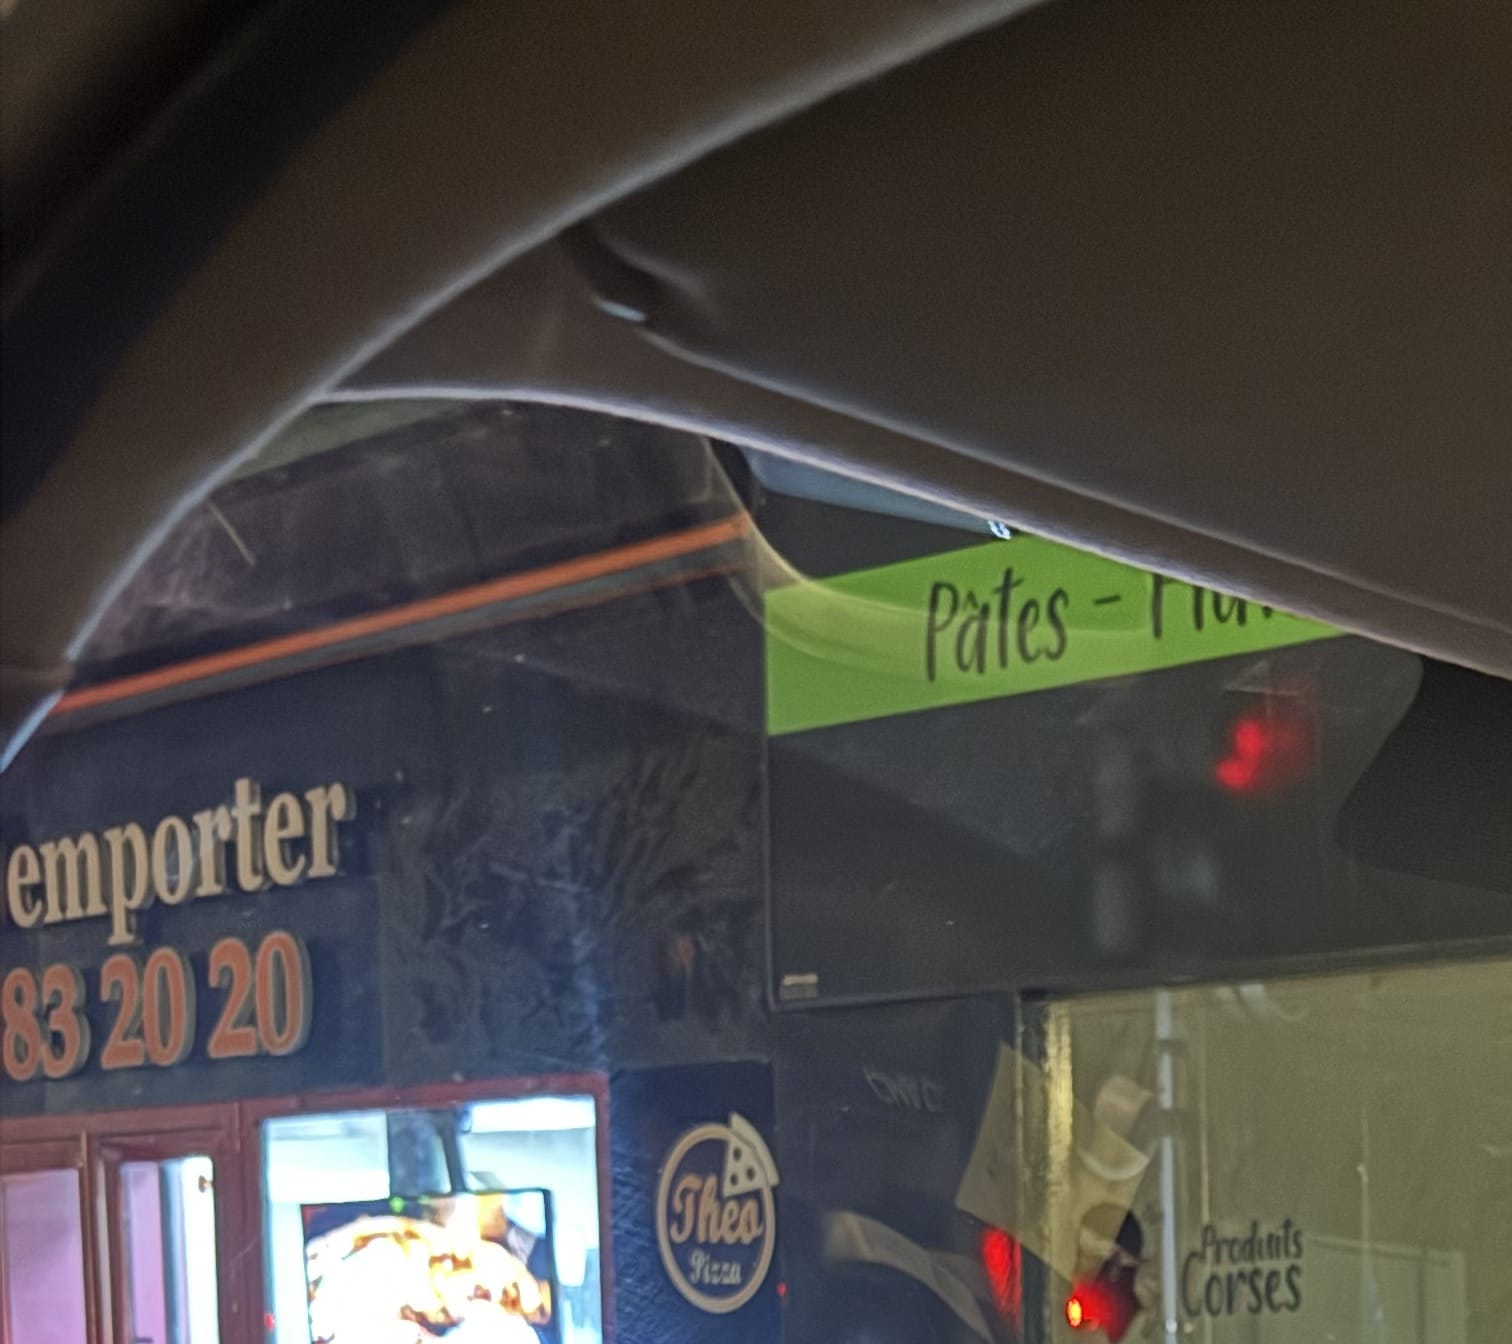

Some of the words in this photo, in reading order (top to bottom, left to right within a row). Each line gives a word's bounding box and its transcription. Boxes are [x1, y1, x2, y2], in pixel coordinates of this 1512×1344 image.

[925, 566, 1070, 684] Pâtes
[7, 777, 352, 945] emporter
[1, 962, 86, 1082] 83
[101, 946, 192, 1070] 20
[207, 930, 308, 1059] 20
[690, 1252, 742, 1286] Pizza
[1181, 1251, 1303, 1318] Corses
[1202, 1218, 1303, 1264] Produits
